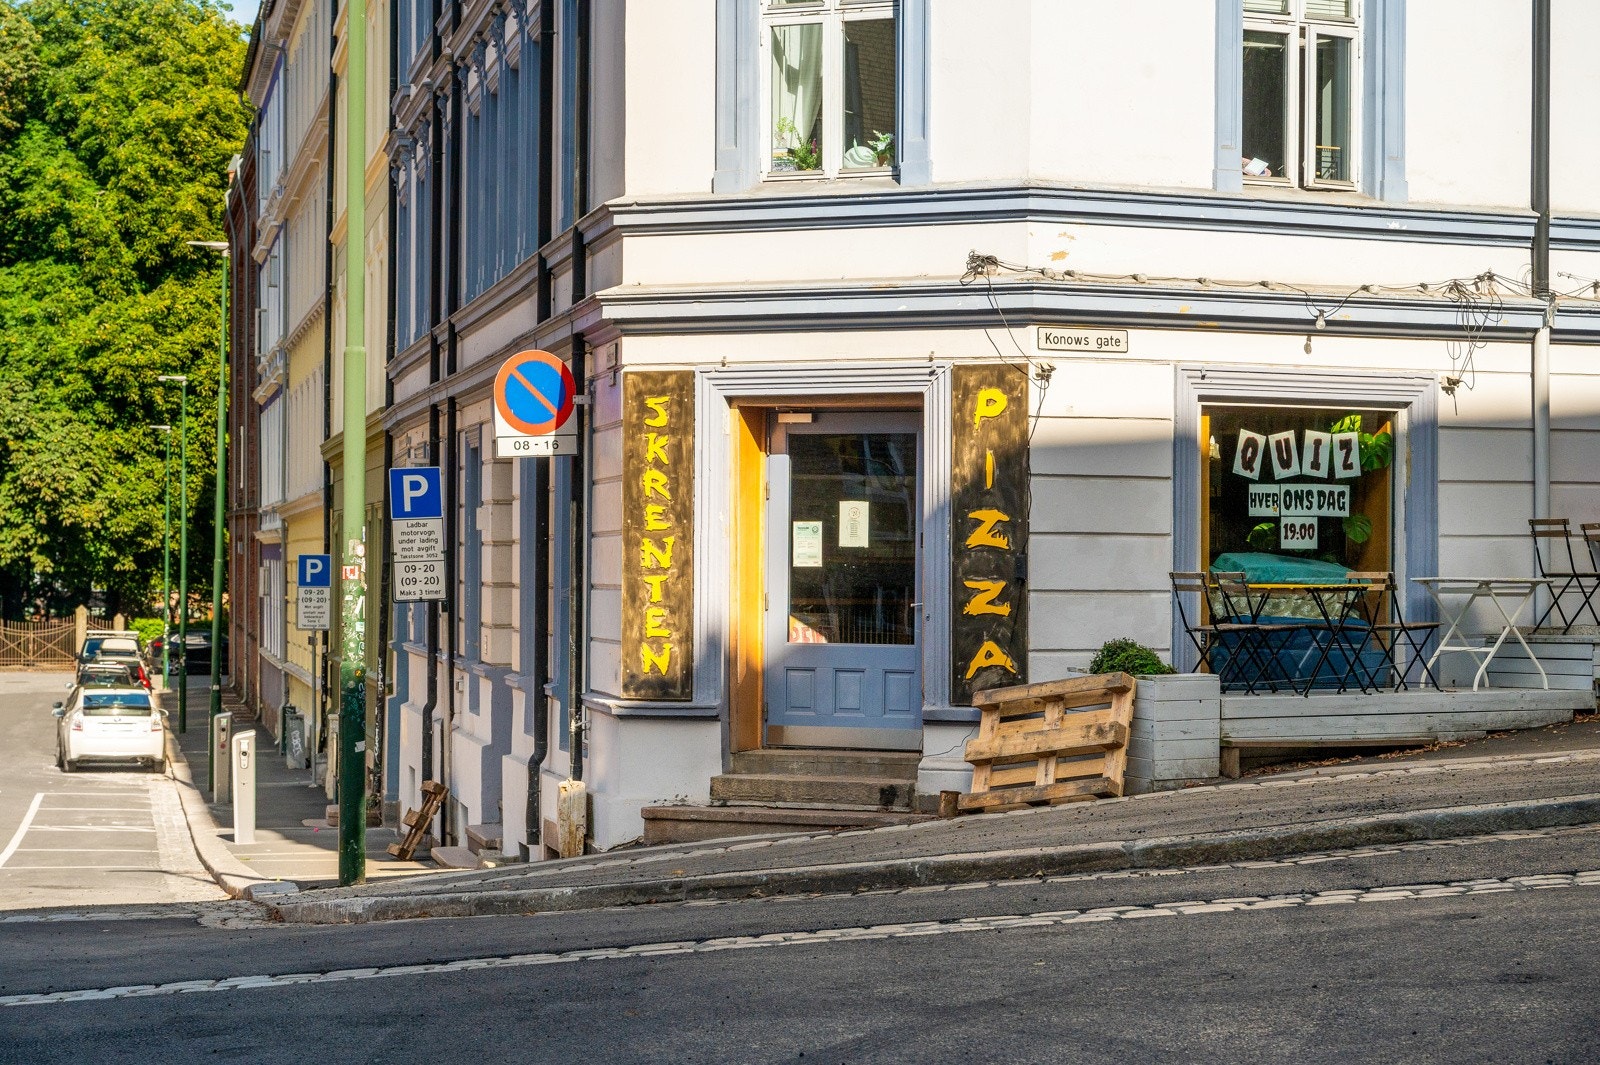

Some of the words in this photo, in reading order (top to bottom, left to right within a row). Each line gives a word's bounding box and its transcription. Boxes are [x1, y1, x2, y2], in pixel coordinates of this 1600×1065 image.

[1045, 332, 1090, 346] Konows
[1096, 335, 1121, 349] gate
[1240, 436, 1354, 474] QUIZ
[402, 474, 429, 512] P
[1249, 492, 1279, 509] HVER
[400, 529, 436, 537] motorvogn
[640, 396, 676, 676] SKRENTEN
[963, 388, 1017, 680] PIZZA
[1283, 522, 1315, 540] 19:00
[417, 545, 436, 553] avgift
[305, 558, 323, 583] P
